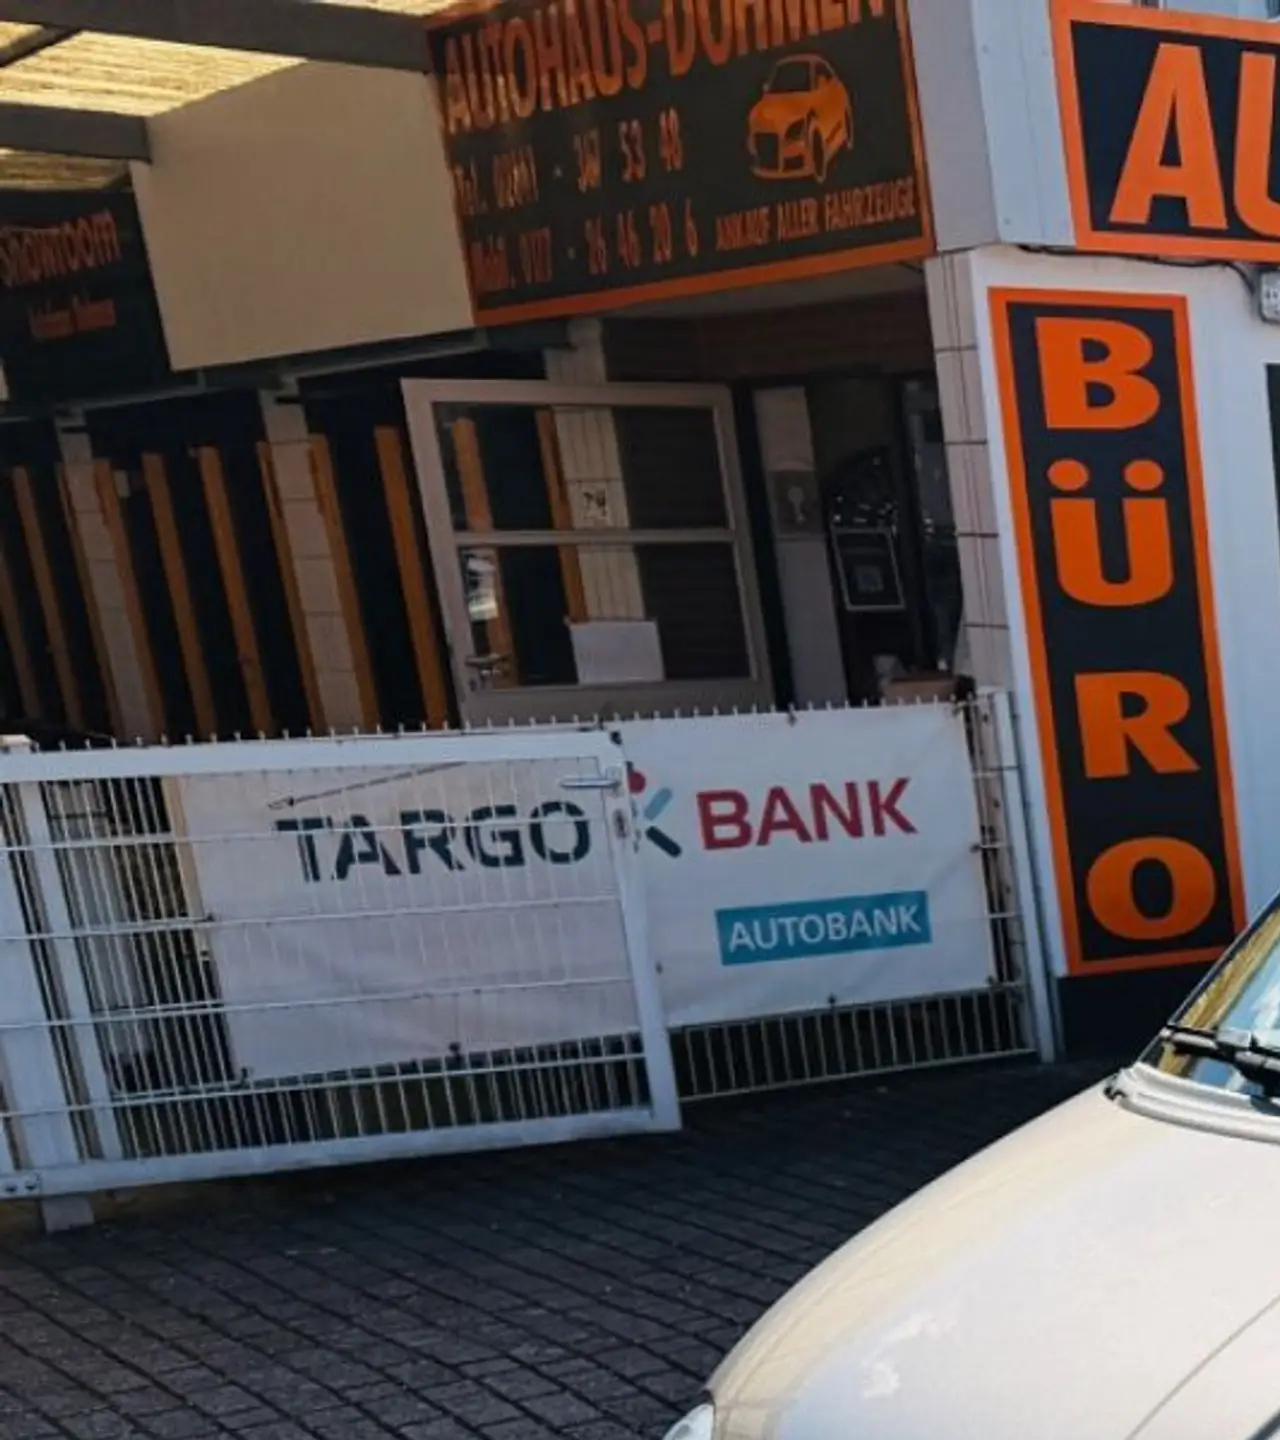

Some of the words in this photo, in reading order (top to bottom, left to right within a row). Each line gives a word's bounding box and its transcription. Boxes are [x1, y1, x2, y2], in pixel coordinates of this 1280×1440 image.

[444, 0, 884, 134] AUTOHAUS-DOH
[777, 197, 820, 242] ALLER
[824, 177, 916, 232] FAHRZEUGE
[1034, 316, 1216, 940] BÜRO
[696, 776, 920, 852] BANK
[728, 905, 923, 956] AUTOBANK
